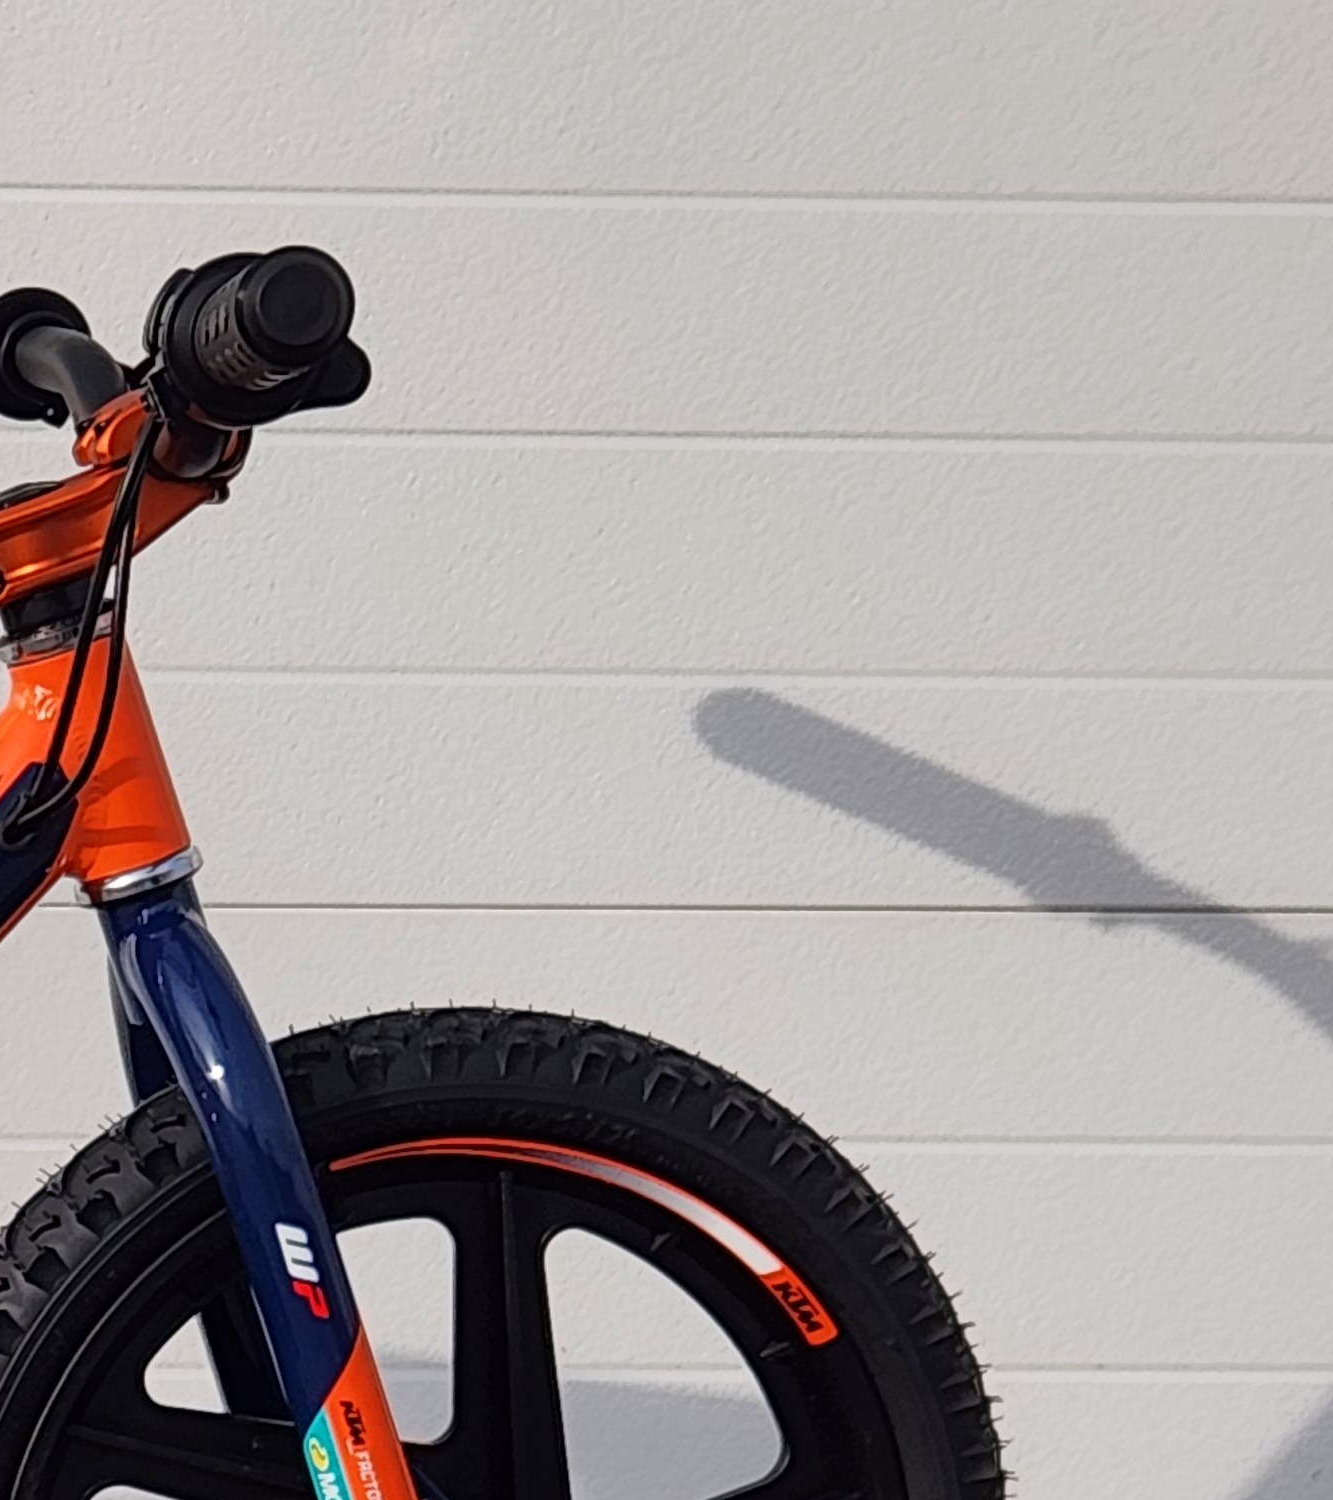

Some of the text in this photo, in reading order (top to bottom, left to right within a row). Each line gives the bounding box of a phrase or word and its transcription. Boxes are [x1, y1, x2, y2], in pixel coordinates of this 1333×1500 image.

[274, 1222, 330, 1319] WP
[771, 1281, 824, 1333] KTM
[339, 1400, 366, 1447] KTM
